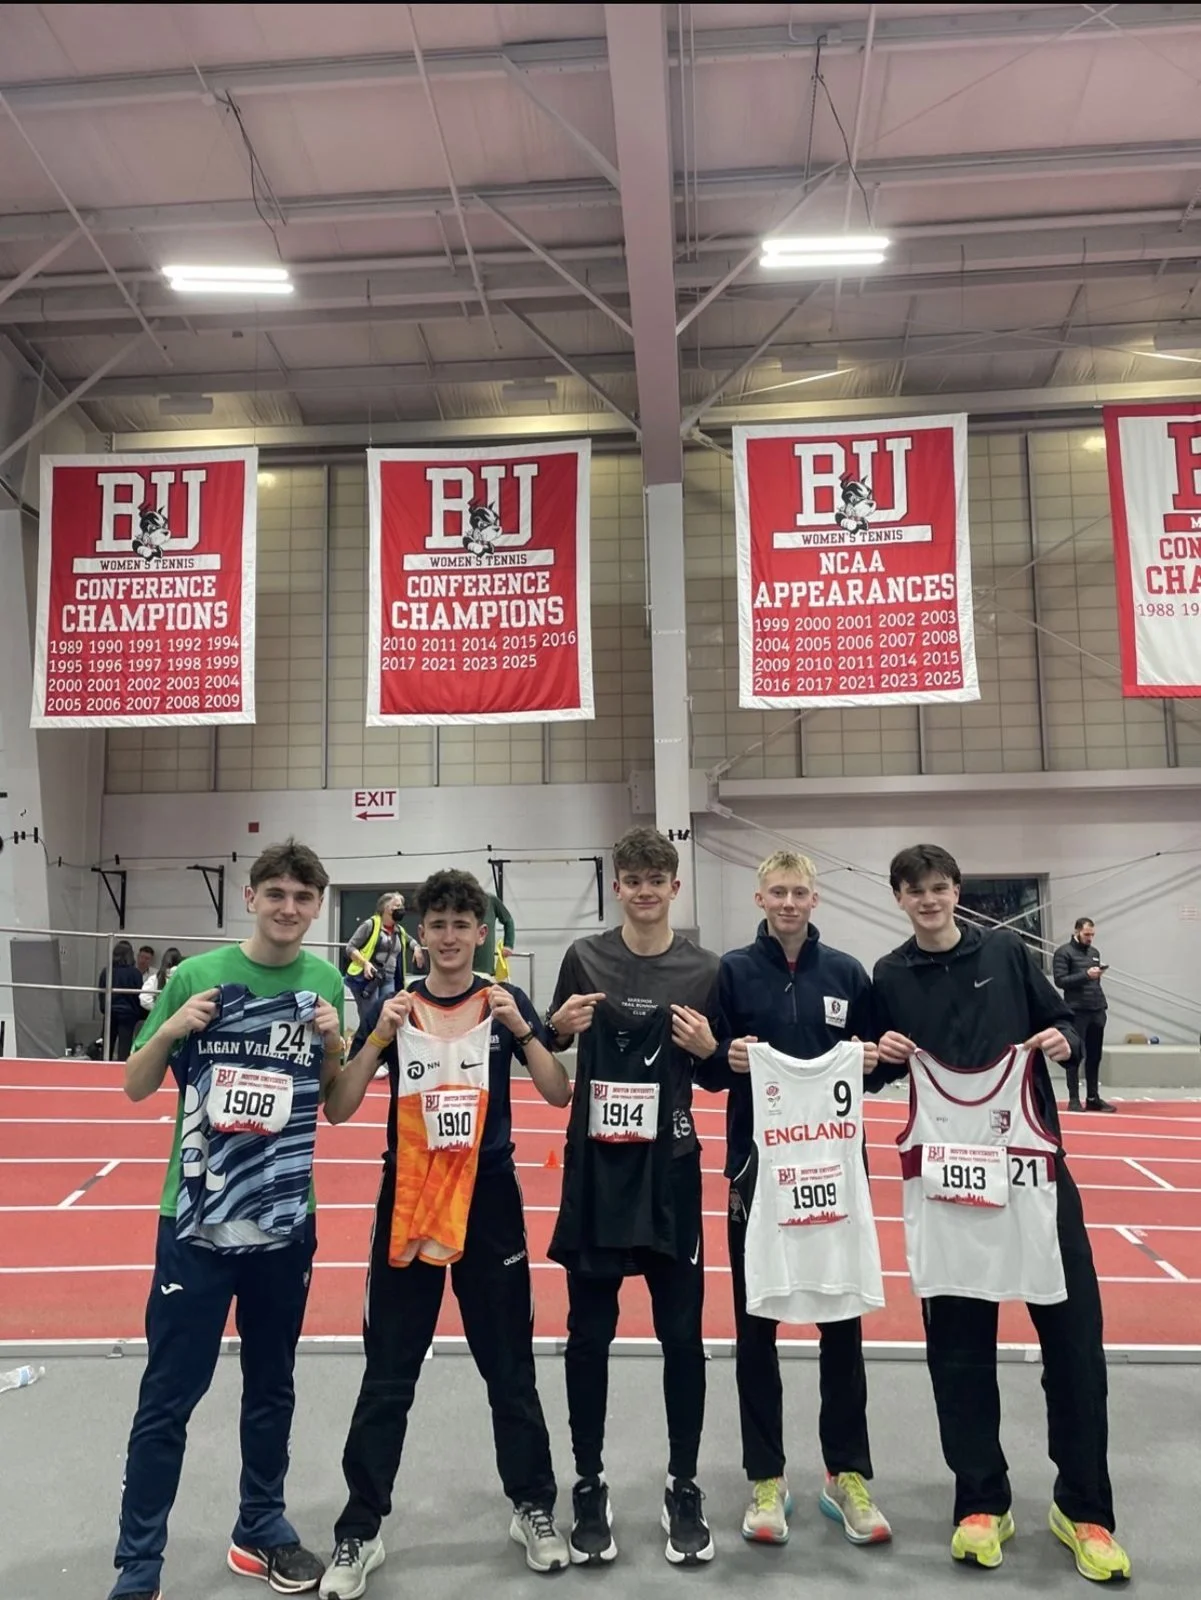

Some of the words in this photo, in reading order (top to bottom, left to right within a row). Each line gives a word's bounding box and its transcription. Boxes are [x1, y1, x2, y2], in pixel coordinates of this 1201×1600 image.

[1167, 421, 1201, 510] B
[794, 437, 912, 526] BU
[96, 470, 206, 552] BU
[425, 464, 538, 549] BU
[802, 533, 855, 545] WOMEN'S
[860, 530, 903, 542] TENNIS
[100, 560, 151, 570] WOMEN'S
[154, 558, 194, 569] TENNIS
[430, 556, 482, 567] WOMEN'S
[486, 554, 527, 566] TENNIS
[820, 550, 885, 575] NCAA
[75, 576, 215, 600] CONFERENCE
[407, 572, 549, 598] CONFERENCE
[754, 574, 955, 608] APPEARANCES
[62, 601, 227, 632] CHAMPIONS
[392, 596, 564, 630] CHAMPIONS
[1138, 602, 1175, 616] 1988
[1183, 602, 1200, 617] 19
[755, 618, 789, 632] 1999
[795, 617, 831, 631] 2000
[837, 615, 872, 629] 2001
[879, 613, 915, 627] 2002
[921, 610, 956, 625] 2003
[50, 640, 82, 654] 1989
[89, 640, 123, 653] 1990
[129, 639, 161, 653] 1991
[168, 638, 201, 652] 1992
[207, 636, 239, 650] 1994
[383, 637, 416, 651] 2010
[422, 638, 456, 652] 2011
[462, 637, 497, 651] 2014
[503, 635, 536, 649] 2015
[542, 631, 576, 647] 2016
[755, 638, 790, 652] 2004
[796, 637, 831, 651] 2005
[837, 636, 873, 650] 2006
[880, 633, 915, 647] 2007
[922, 630, 958, 645] 2008
[49, 660, 82, 673] 1995
[89, 659, 122, 672] 1996
[128, 659, 160, 672] 1997
[168, 657, 201, 670] 1998
[206, 655, 238, 669] 1999
[382, 657, 414, 670] 2017
[422, 657, 455, 670] 2021
[463, 656, 497, 670] 2023
[503, 655, 536, 668] 2025
[756, 658, 790, 672] 2009
[796, 657, 832, 671] 2010
[838, 656, 873, 670] 2011
[880, 653, 917, 668] 2014
[923, 651, 959, 666] 2015
[49, 679, 82, 692] 2000
[87, 679, 120, 692] 2001
[127, 678, 160, 691] 2002
[166, 677, 199, 690] 2003
[205, 675, 239, 688] 2004
[755, 678, 790, 692] 2016
[797, 677, 832, 691] 2017
[839, 675, 875, 689] 2021
[881, 674, 918, 688] 2023
[925, 672, 961, 686] 2025
[47, 698, 81, 711] 2005
[87, 698, 120, 711] 2006
[126, 697, 160, 710] 2007
[166, 696, 199, 709] 2008
[205, 694, 239, 708] 2009
[355, 791, 396, 806] EXIT
[276, 1023, 305, 1052] 24
[198, 1040, 240, 1055] LAGAN
[293, 1052, 314, 1067] AC
[217, 1069, 237, 1083] BU
[427, 1061, 441, 1070] NN
[426, 1095, 440, 1108] BU
[594, 1084, 608, 1097] BU
[834, 1080, 851, 1117] 9
[223, 1089, 275, 1117] 1908
[438, 1112, 470, 1136] 1910
[603, 1103, 643, 1126] 1914
[764, 1122, 856, 1146] ENGLAND
[928, 1146, 945, 1160] BU
[778, 1168, 796, 1182] BU
[943, 1165, 986, 1189] 1913
[1011, 1158, 1038, 1187] 21
[792, 1183, 836, 1209] 1909
